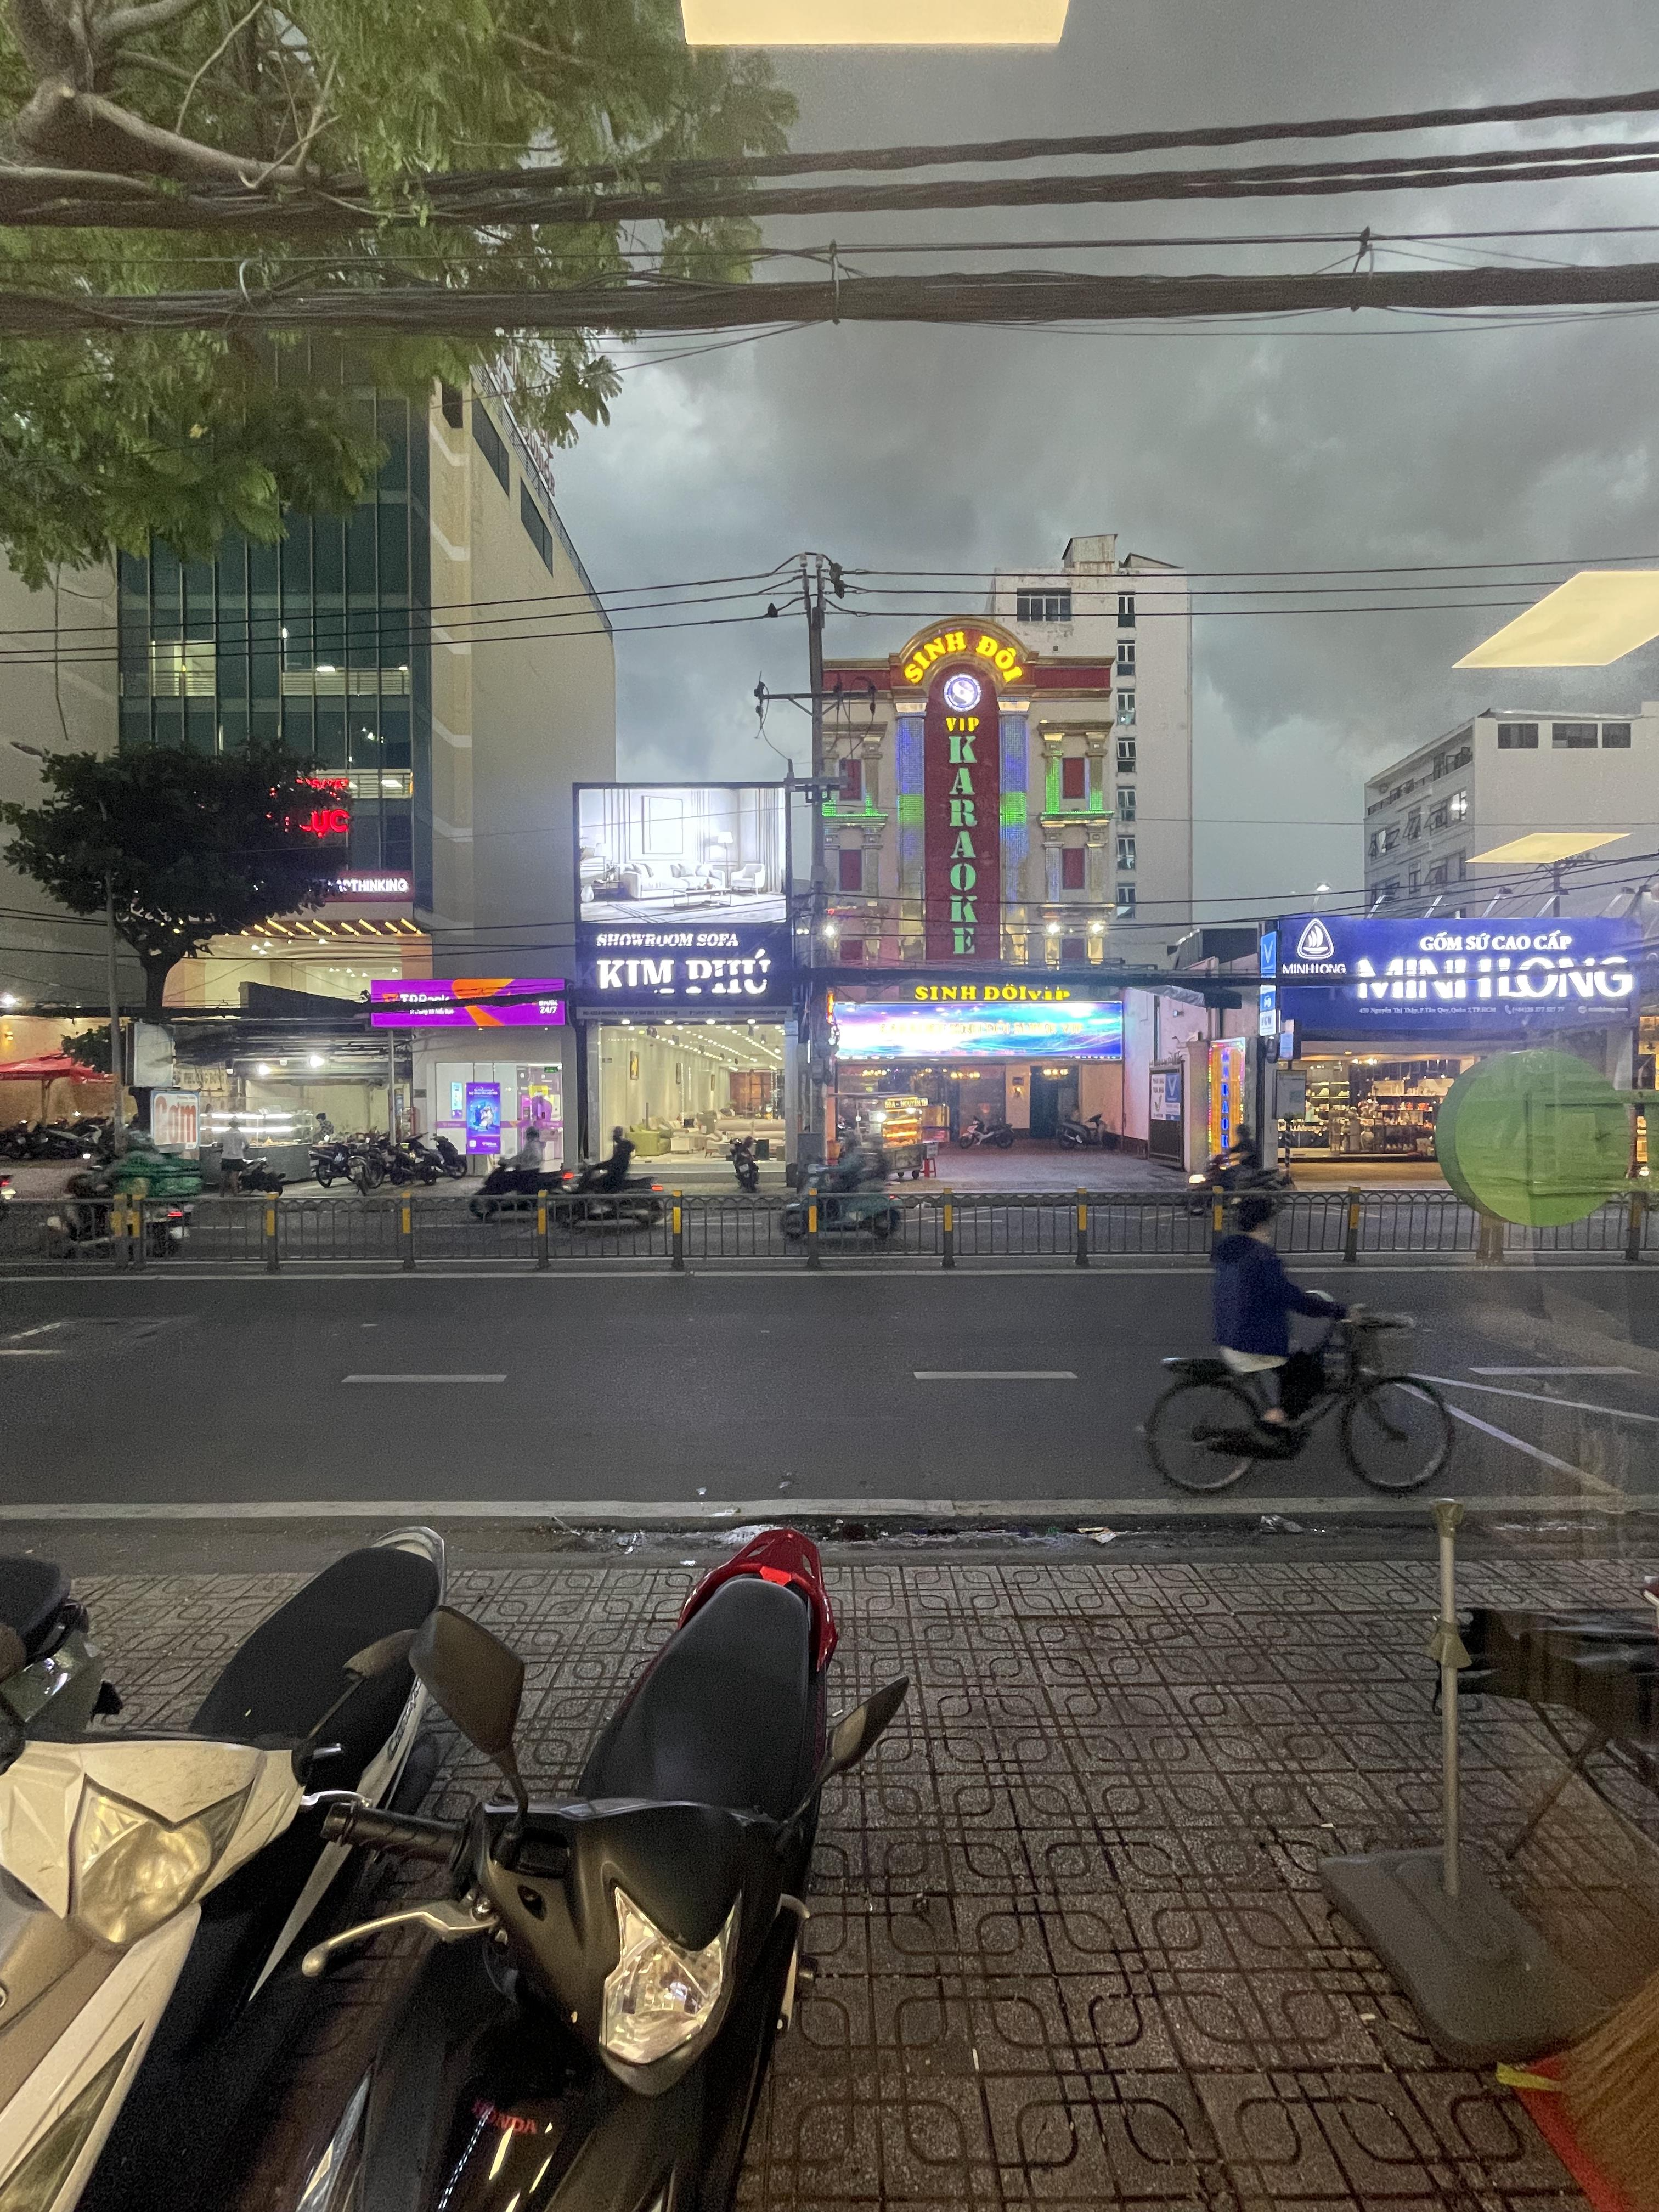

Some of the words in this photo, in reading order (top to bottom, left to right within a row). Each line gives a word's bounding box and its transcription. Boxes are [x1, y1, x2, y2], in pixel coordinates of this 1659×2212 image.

[904, 631, 966, 684] SINH
[975, 635, 1023, 683] ĐÔI
[946, 717, 979, 732] VIP
[949, 736, 978, 954] KARAOKE
[596, 933, 694, 947] SHOWROOM
[696, 933, 739, 947] SOFA
[1420, 932, 1463, 951] GỐM
[1465, 933, 1491, 950] SỨ
[1491, 936, 1531, 950] CAO
[1533, 930, 1573, 950] CẤP
[596, 959, 675, 994] KIM
[685, 948, 771, 994] PHÚ
[915, 986, 977, 1001] SINH
